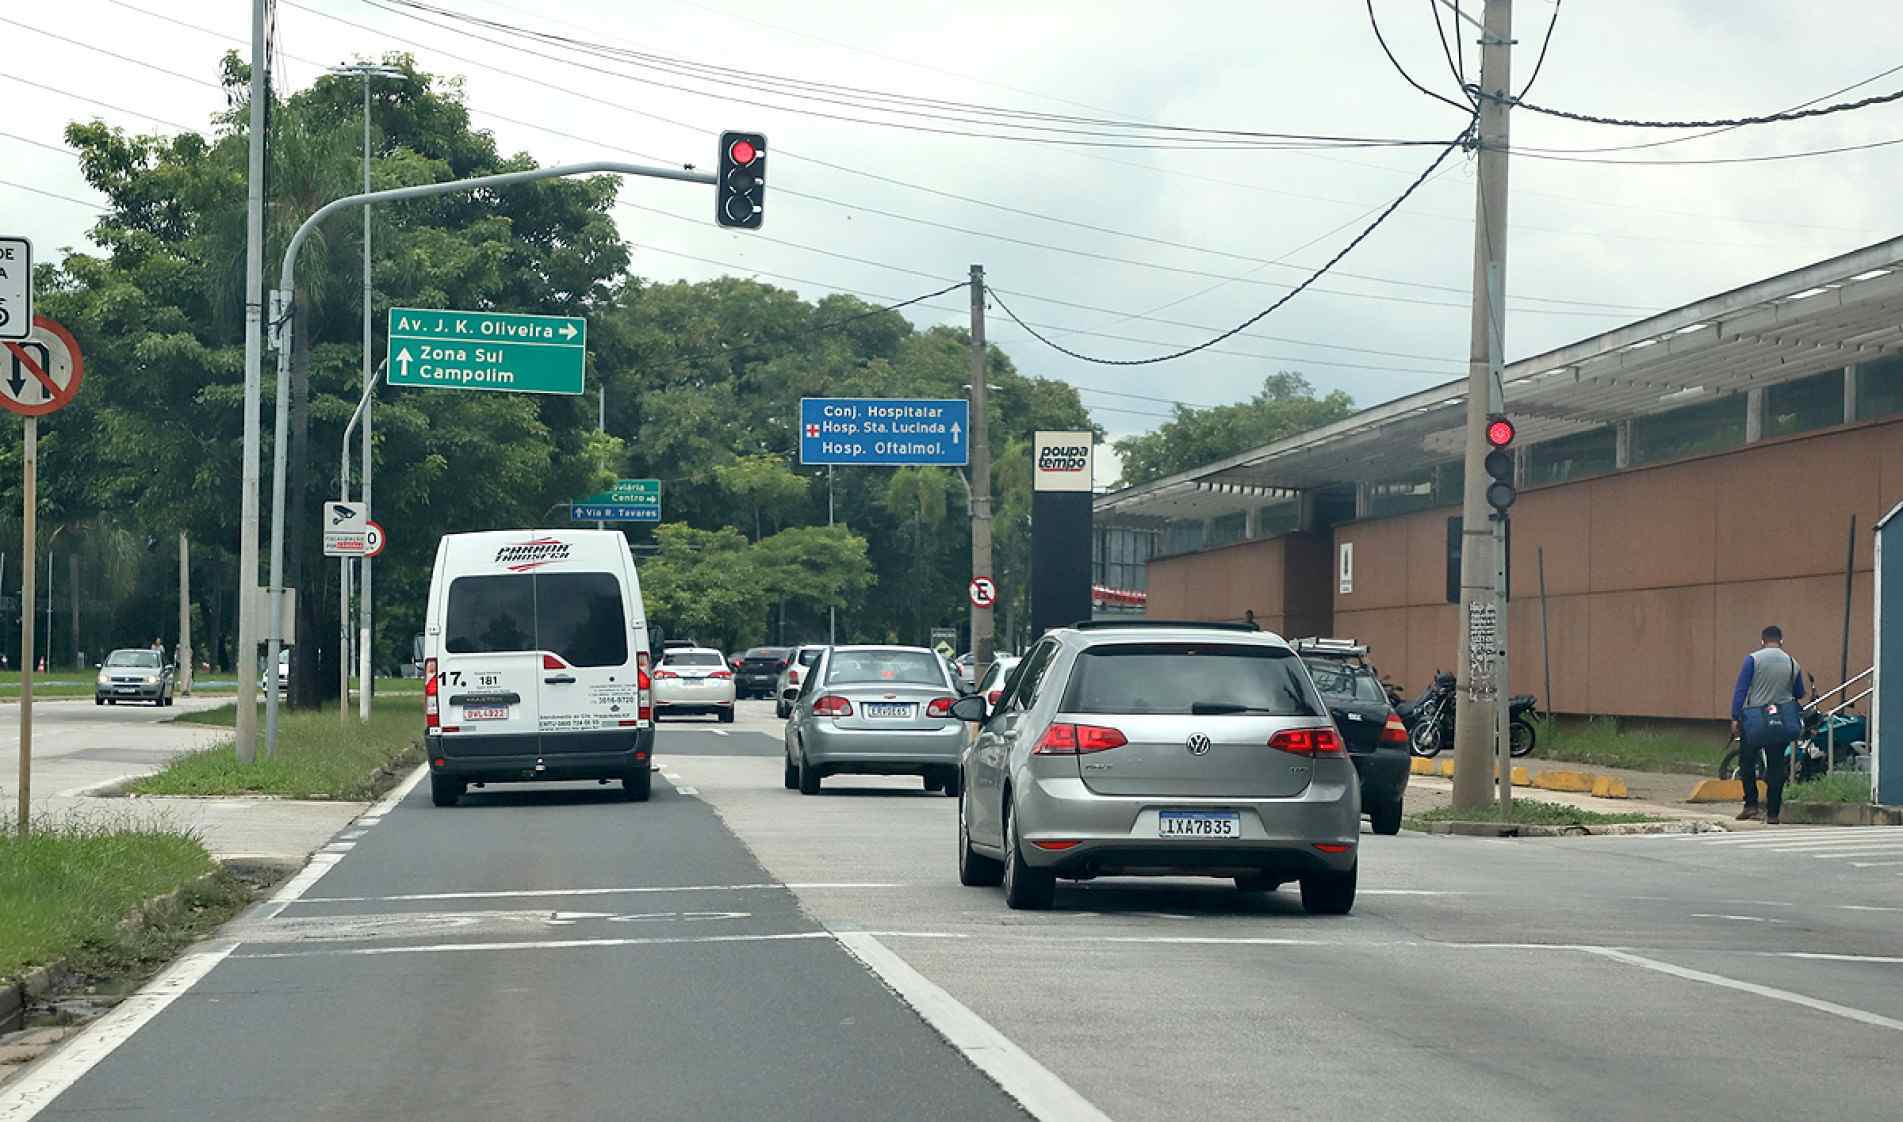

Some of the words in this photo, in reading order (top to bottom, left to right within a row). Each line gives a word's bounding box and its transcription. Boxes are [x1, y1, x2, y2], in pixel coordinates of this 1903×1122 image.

[397, 316, 427, 331] Av.
[434, 318, 448, 333] J.
[455, 319, 474, 334] K.
[480, 321, 553, 338] Oliveira
[420, 345, 466, 361] Zona
[475, 348, 503, 363] Sul
[419, 365, 514, 384] Campolim
[823, 405, 862, 420] Conj.
[868, 405, 943, 420] Hospitalar
[822, 420, 860, 435] Hosp.
[863, 421, 889, 434] Sta.
[892, 421, 945, 434] Lucinda
[822, 441, 867, 457] Hosp.
[874, 441, 945, 455] Oftalmol.
[1041, 446, 1089, 460] poupa
[1038, 457, 1086, 470] tempo
[611, 493, 645, 502] Centro
[586, 508, 602, 517] Via
[619, 508, 657, 518] Tavares
[480, 676, 497, 686] 181
[1167, 818, 1232, 834] IXA7B35
